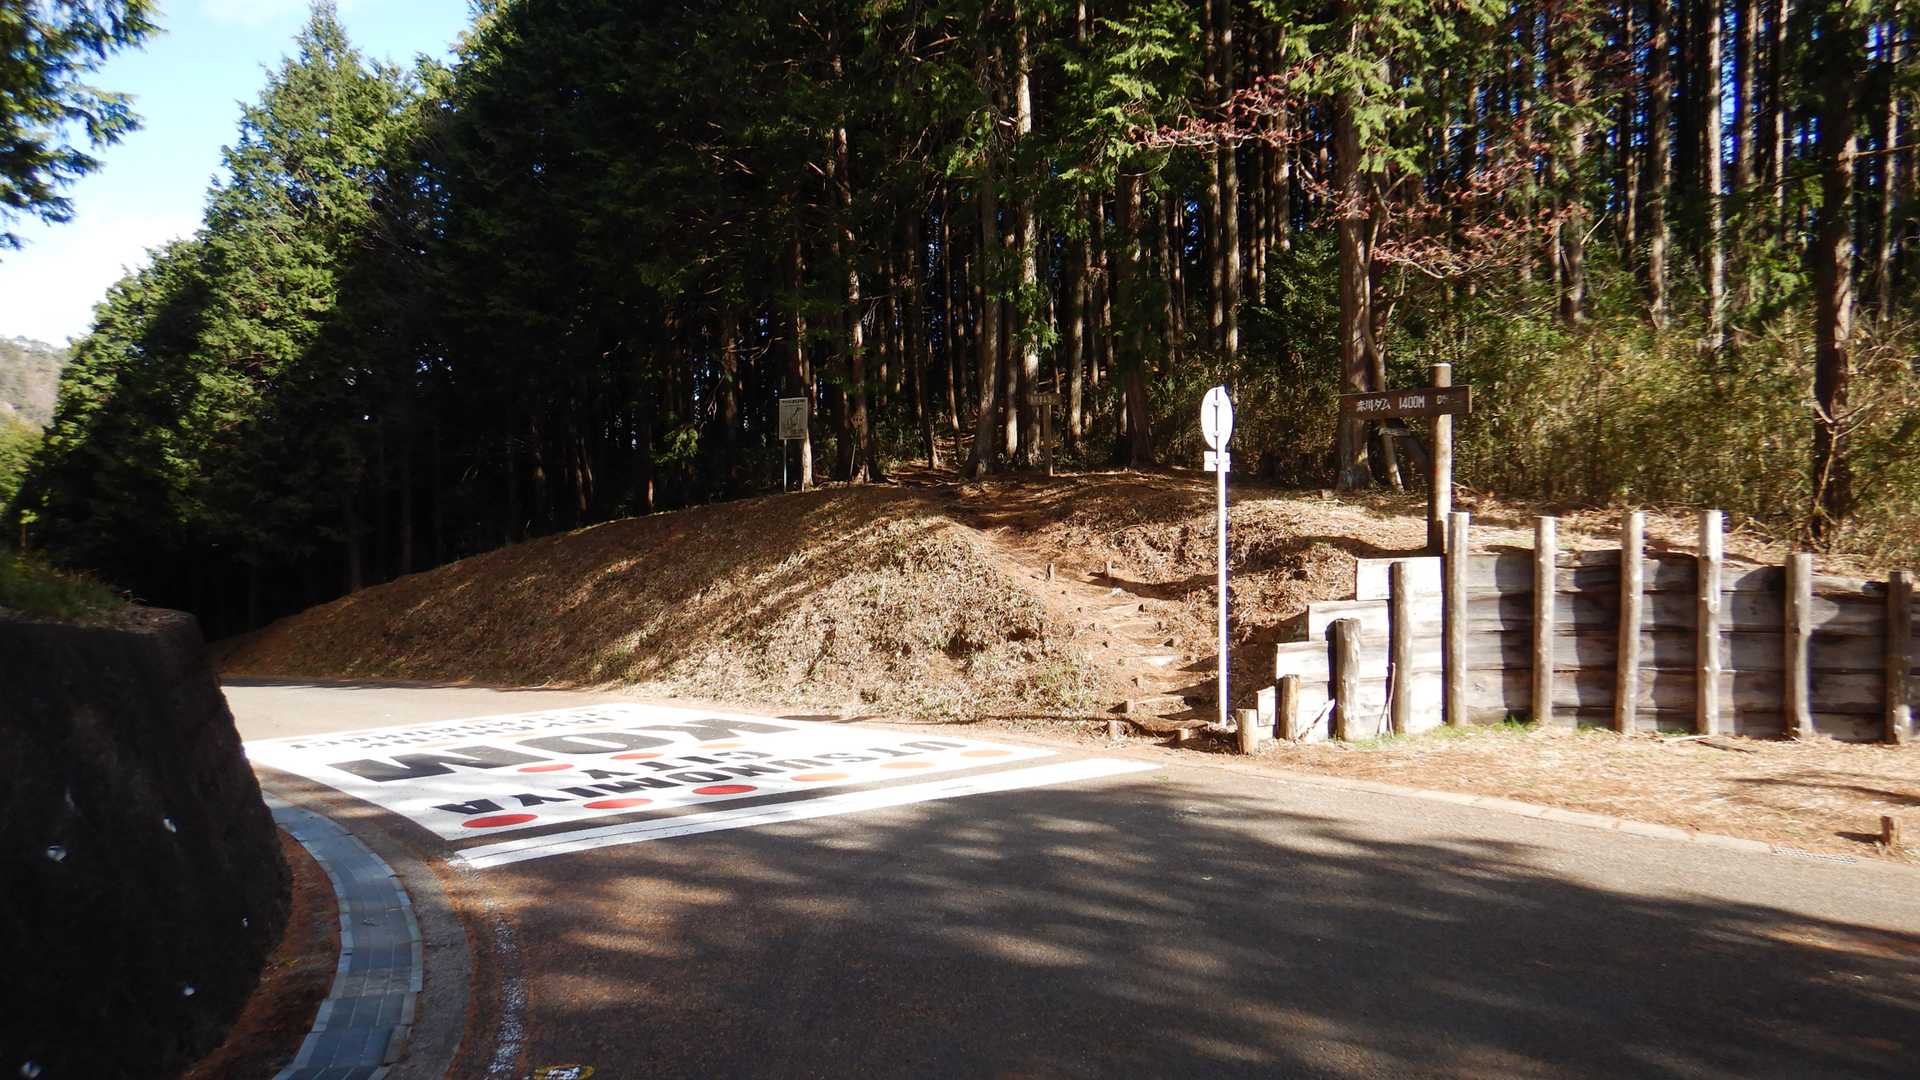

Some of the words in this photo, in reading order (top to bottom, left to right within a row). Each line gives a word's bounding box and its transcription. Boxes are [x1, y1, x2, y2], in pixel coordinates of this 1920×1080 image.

[1398, 395, 1425, 409] 1400M
[328, 717, 798, 783] KOM
[580, 750, 773, 780] CITY
[432, 740, 967, 816] UTSUNOMIYA
